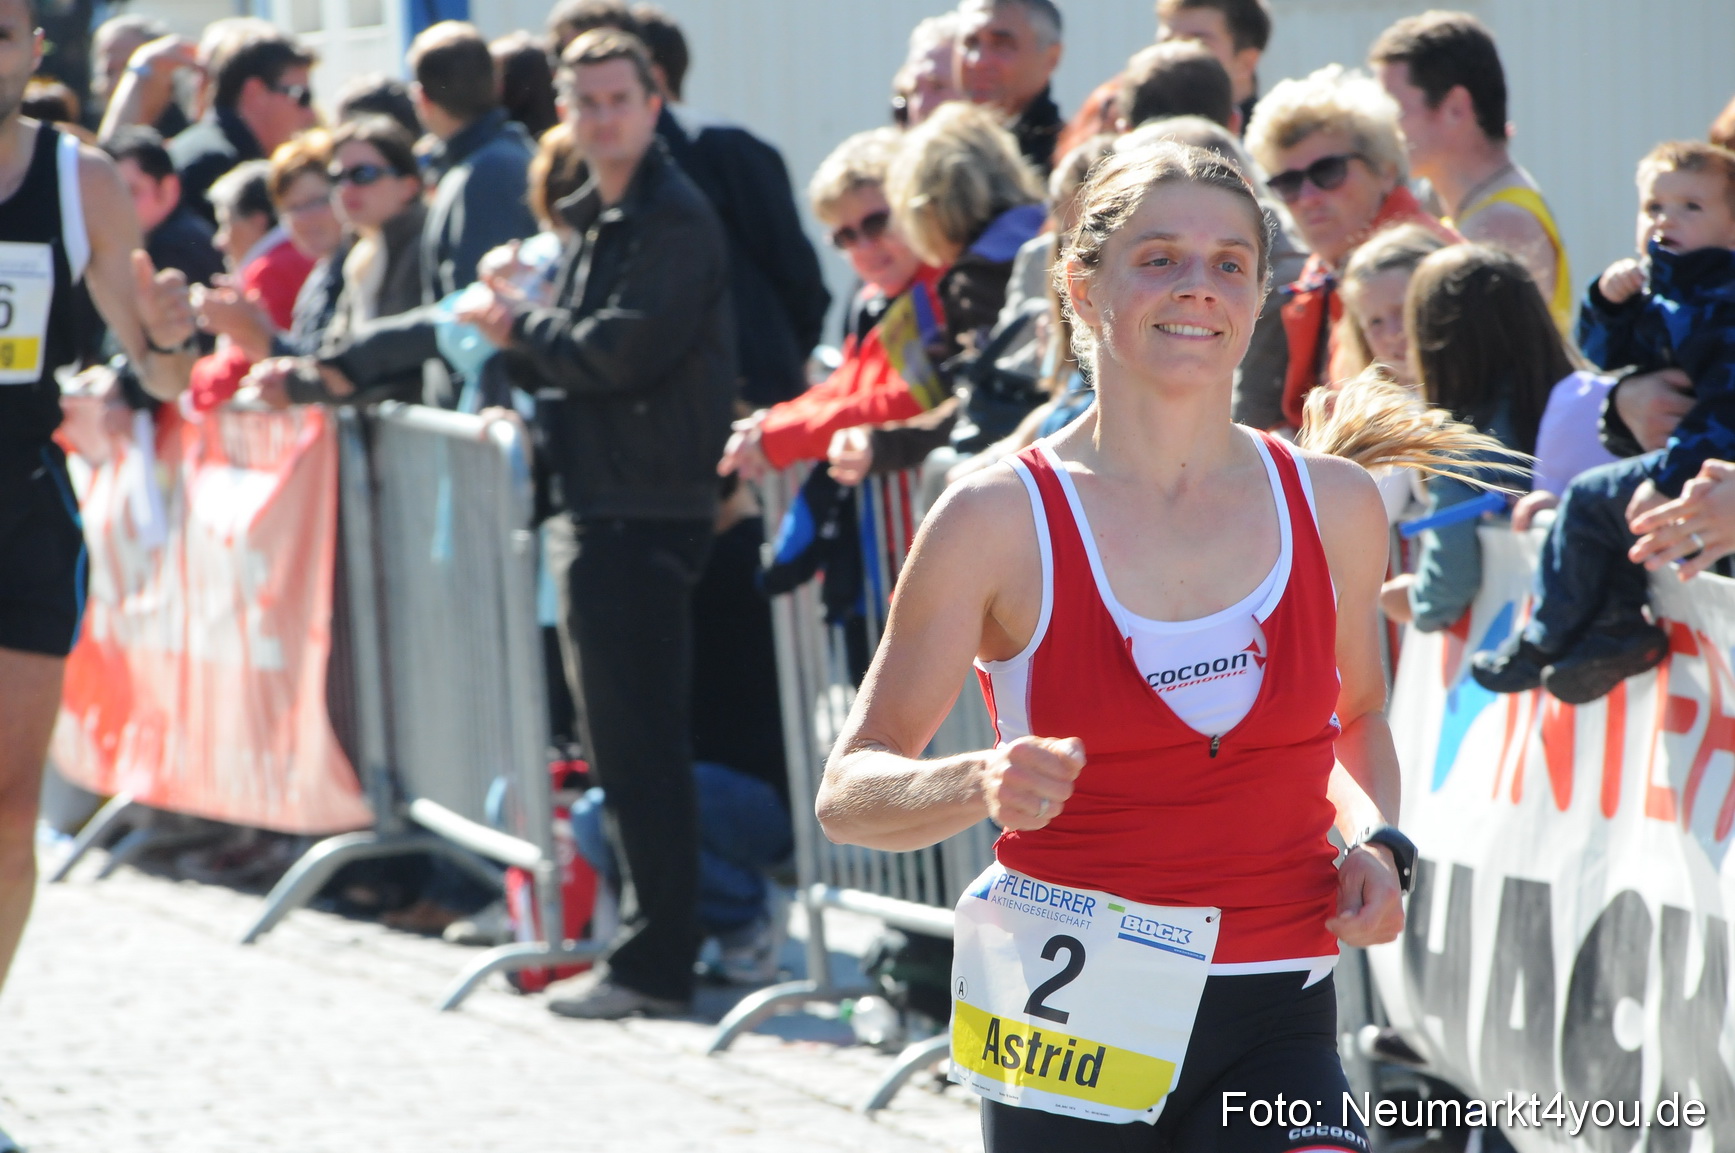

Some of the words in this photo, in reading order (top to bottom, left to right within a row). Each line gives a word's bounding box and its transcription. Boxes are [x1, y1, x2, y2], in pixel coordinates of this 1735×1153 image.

[1146, 653, 1248, 688] cocoon
[990, 895, 1092, 930] AKTIENGESELLSCHAFT
[994, 873, 1097, 918] PFLEIDERER
[1120, 914, 1194, 945] BOCK
[957, 980, 965, 997] A
[1023, 934, 1086, 1025] 2
[981, 1016, 1106, 1089] Astrid
[1288, 1125, 1367, 1149] cocoon
